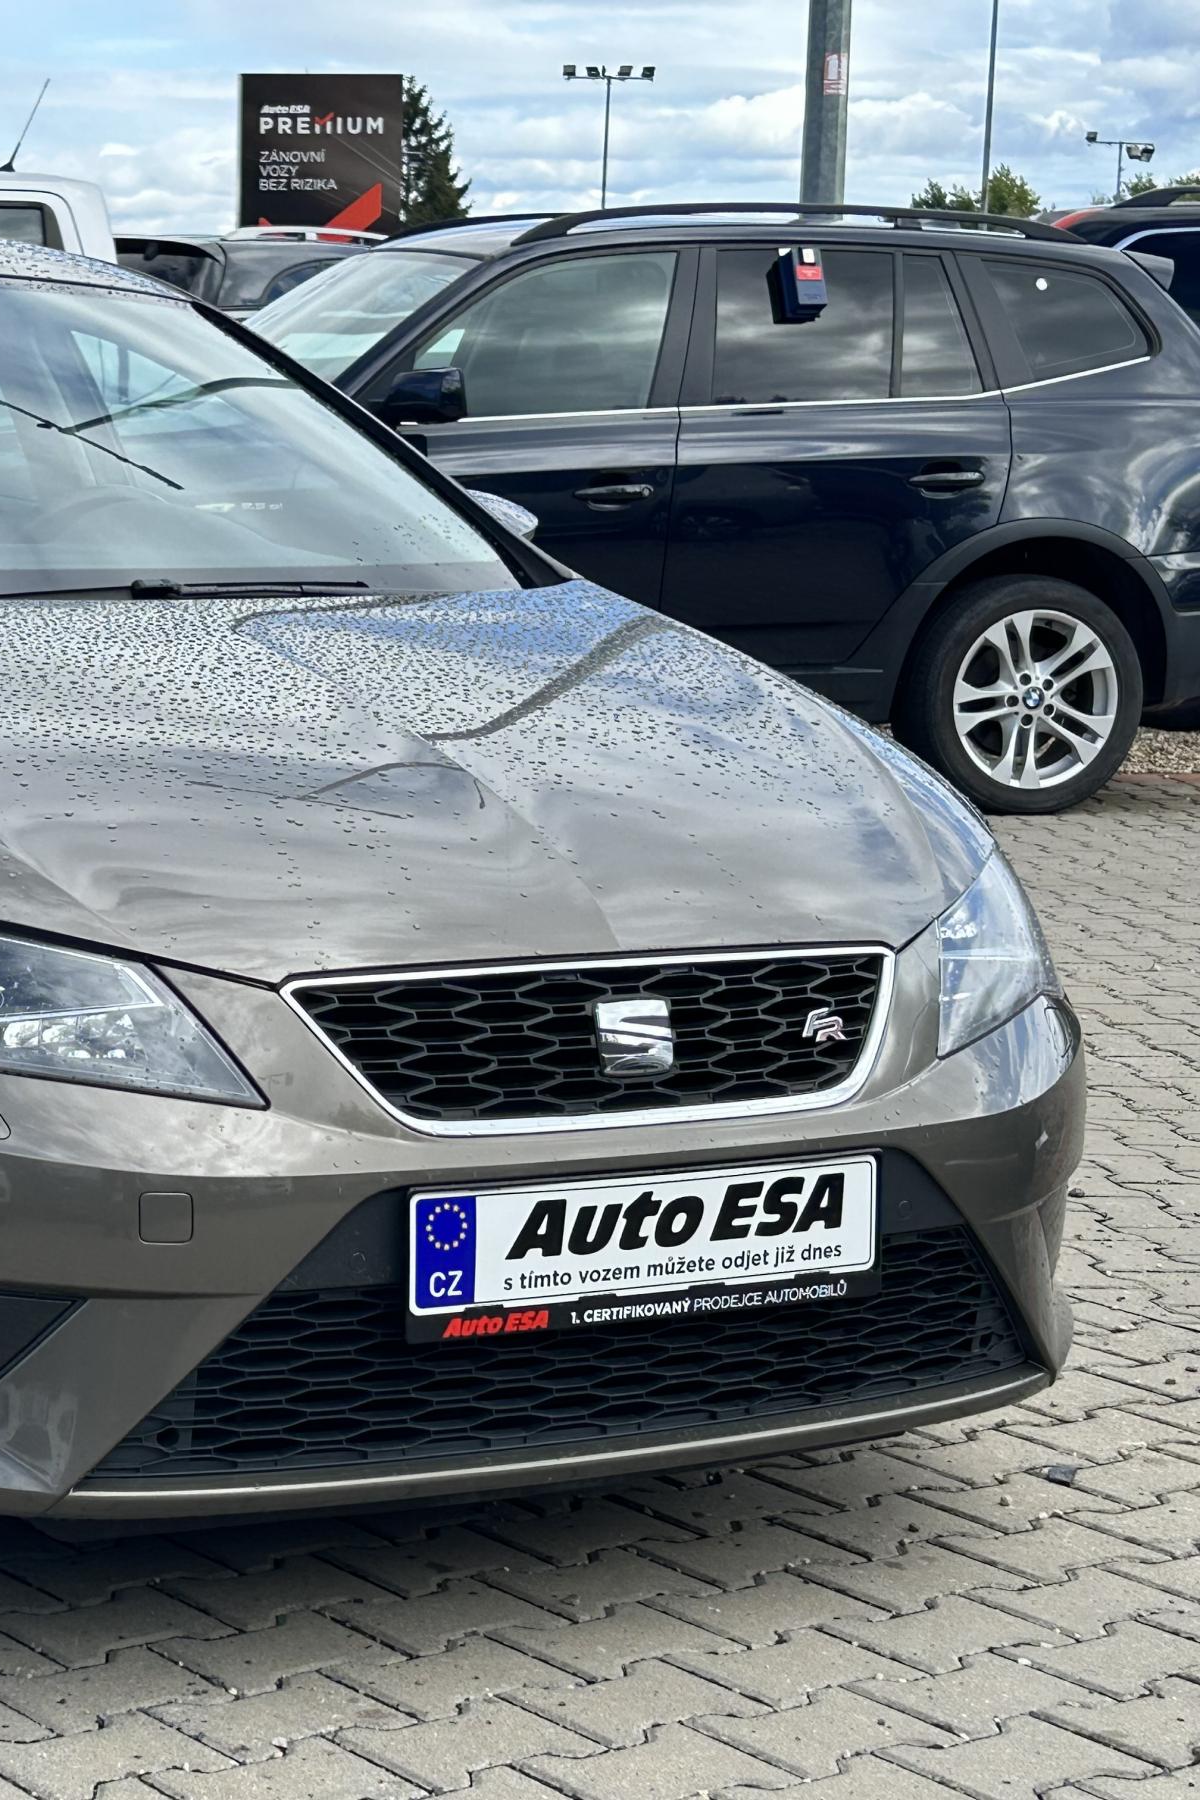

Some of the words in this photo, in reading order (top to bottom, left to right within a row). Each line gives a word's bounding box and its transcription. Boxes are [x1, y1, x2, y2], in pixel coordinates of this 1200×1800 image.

[259, 113, 385, 135] PREMIUM
[259, 148, 326, 163] ZÁNOVNÍ
[258, 165, 299, 177] VOZY
[259, 179, 288, 191] BEZ
[290, 178, 338, 191] RIZIKA
[504, 1190, 705, 1261] Auto
[709, 1172, 845, 1242] ESA
[503, 1277, 513, 1291] s
[520, 1270, 572, 1289] tímto
[578, 1265, 640, 1284] vozem
[647, 1255, 715, 1278] můžete
[721, 1249, 769, 1271] odjet
[773, 1245, 795, 1268] již
[801, 1243, 842, 1261] dnes
[429, 1270, 463, 1298] CZ
[570, 1311, 581, 1325] 1.
[583, 1297, 692, 1323] CERTIFIKOVANÝ
[693, 1292, 762, 1313] PRODEJCE
[764, 1279, 848, 1304] AUTOMOBILŮ
[442, 1315, 503, 1338] Auto
[503, 1310, 549, 1333] ESA
